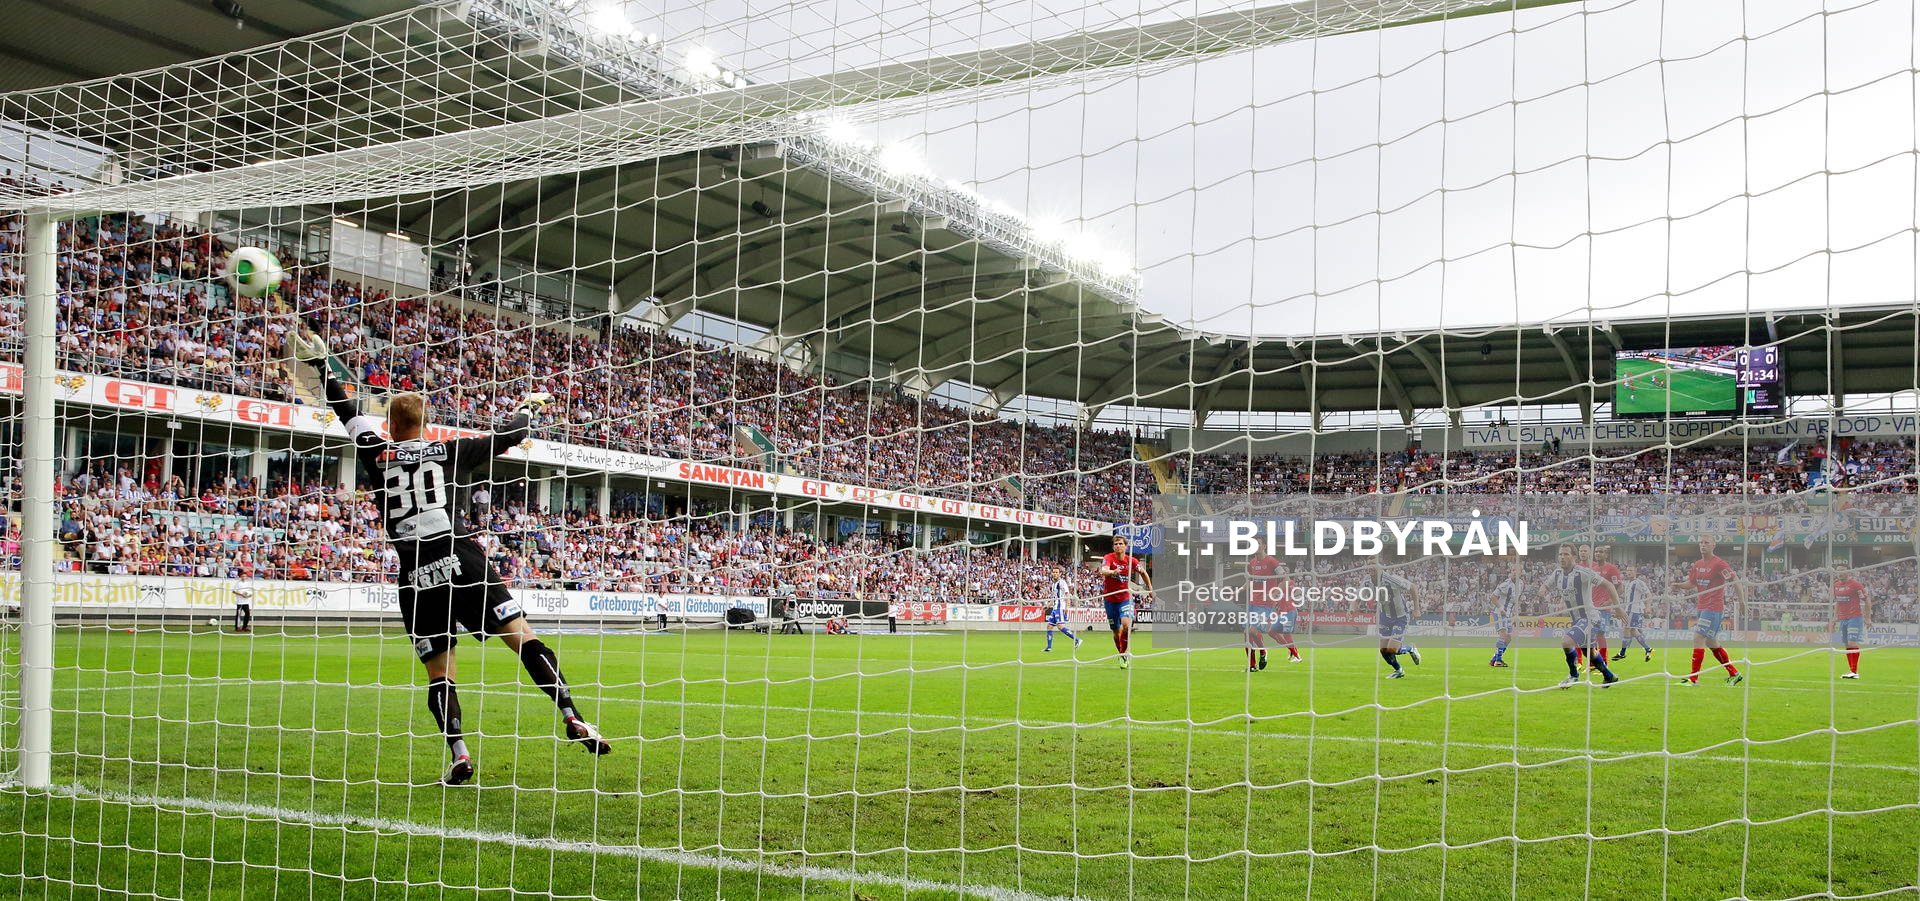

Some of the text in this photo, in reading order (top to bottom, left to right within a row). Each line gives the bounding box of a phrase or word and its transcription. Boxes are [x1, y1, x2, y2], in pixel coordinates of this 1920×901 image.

[1765, 353, 1774, 364] 0
[1739, 369, 1775, 381] 21:34
[105, 381, 177, 411] GT
[237, 399, 299, 427] GT
[615, 455, 626, 468] of
[679, 463, 764, 489] SANKTAN
[383, 461, 448, 519] 30
[802, 480, 830, 497] GT
[852, 487, 878, 503] GT
[899, 494, 922, 509] GT
[941, 500, 963, 514] GT
[980, 506, 999, 519] GT
[1015, 511, 1034, 523] GT
[1048, 516, 1065, 527] GT
[1077, 519, 1094, 531] GT
[1528, 534, 1549, 542] BRO
[536, 593, 569, 612] higab
[1416, 619, 1469, 627] GRUNOS
